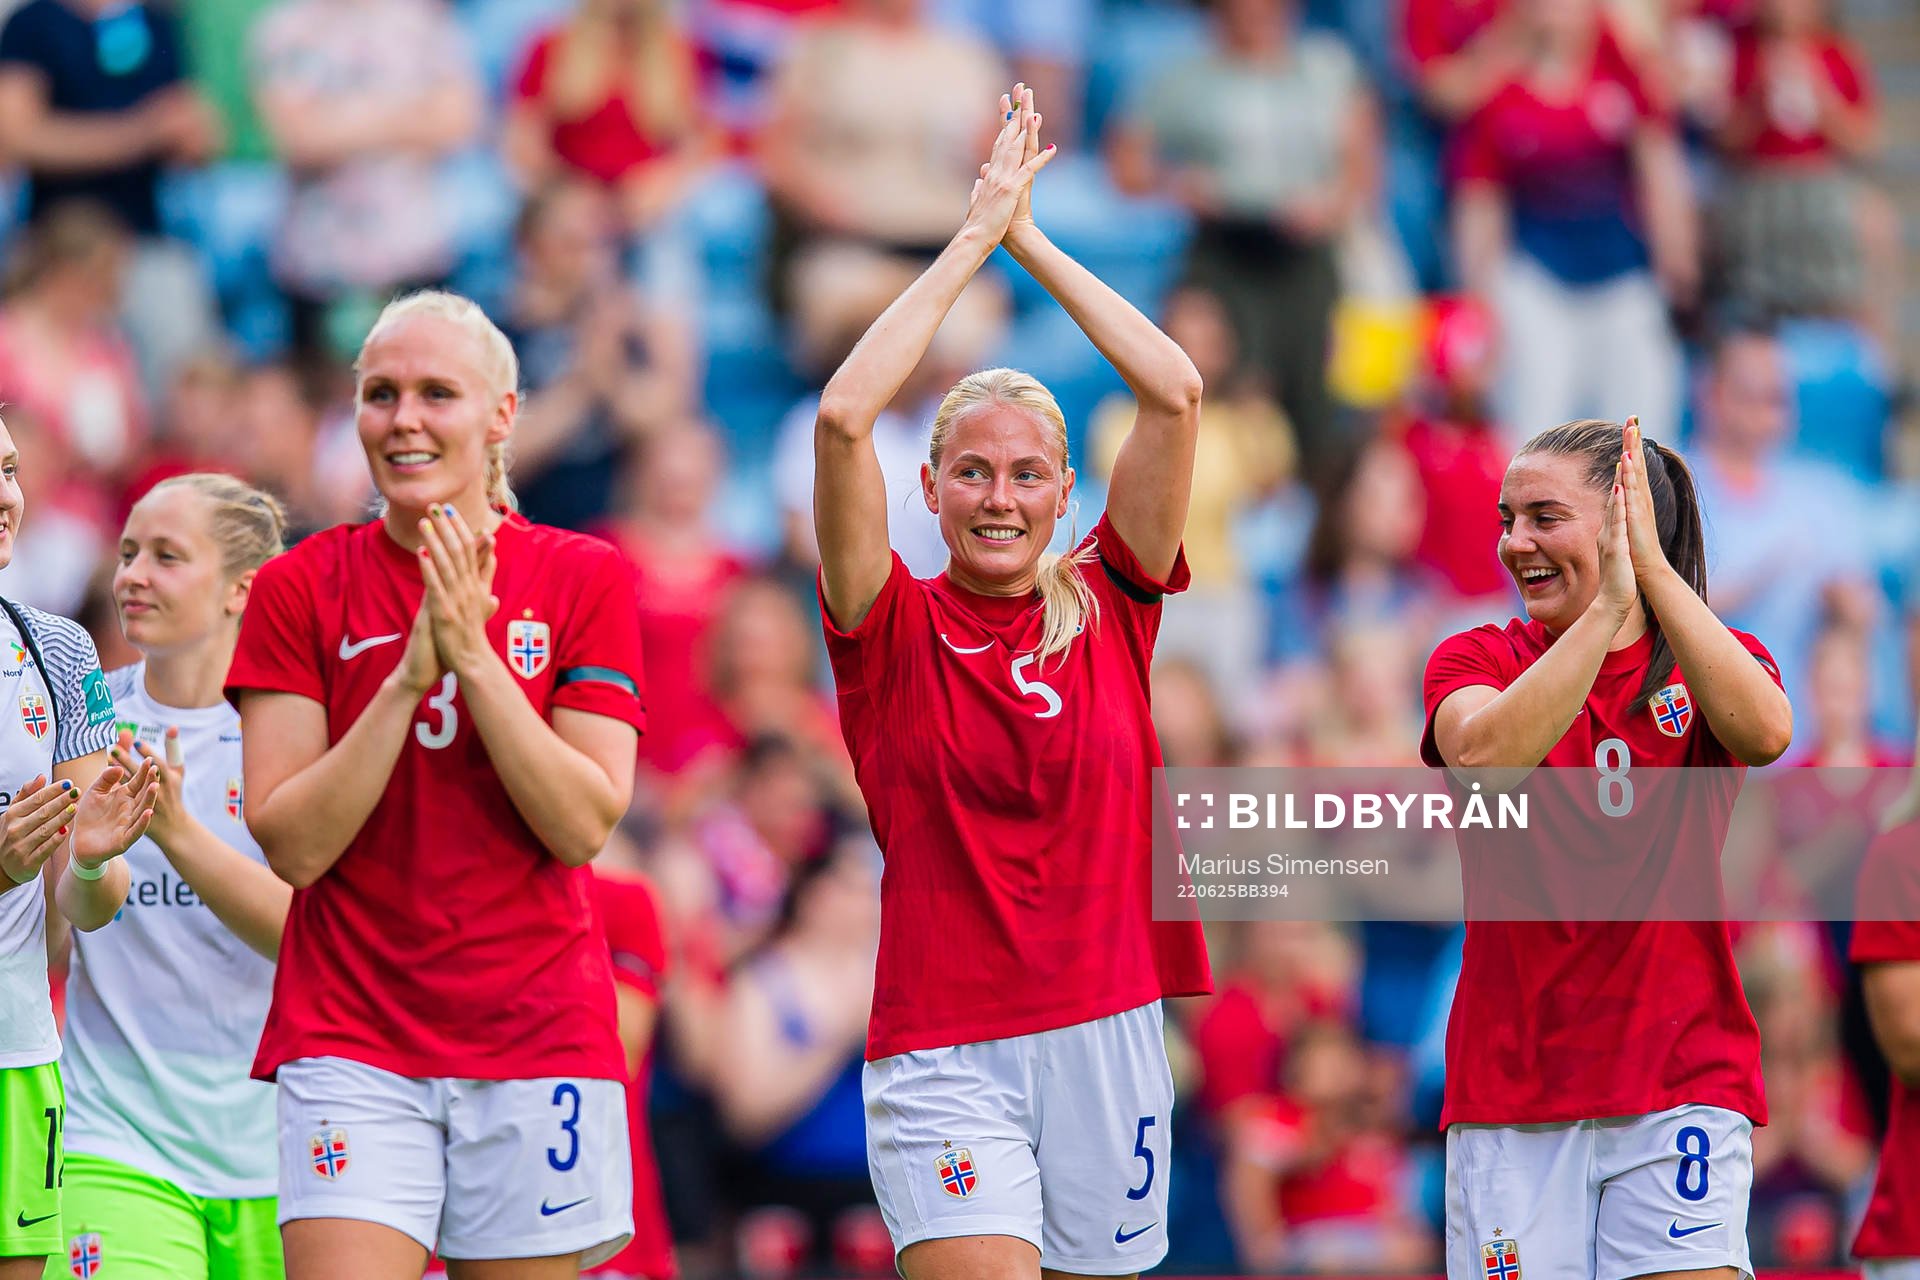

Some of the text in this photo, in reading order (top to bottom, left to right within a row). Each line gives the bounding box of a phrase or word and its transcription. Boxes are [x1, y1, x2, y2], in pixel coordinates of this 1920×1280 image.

[415, 671, 458, 750] 3
[1011, 653, 1062, 718] 5
[1594, 737, 1635, 818] 8
[546, 1083, 581, 1172] 3
[1126, 1115, 1156, 1200] 5
[1675, 1126, 1710, 1200] 8
